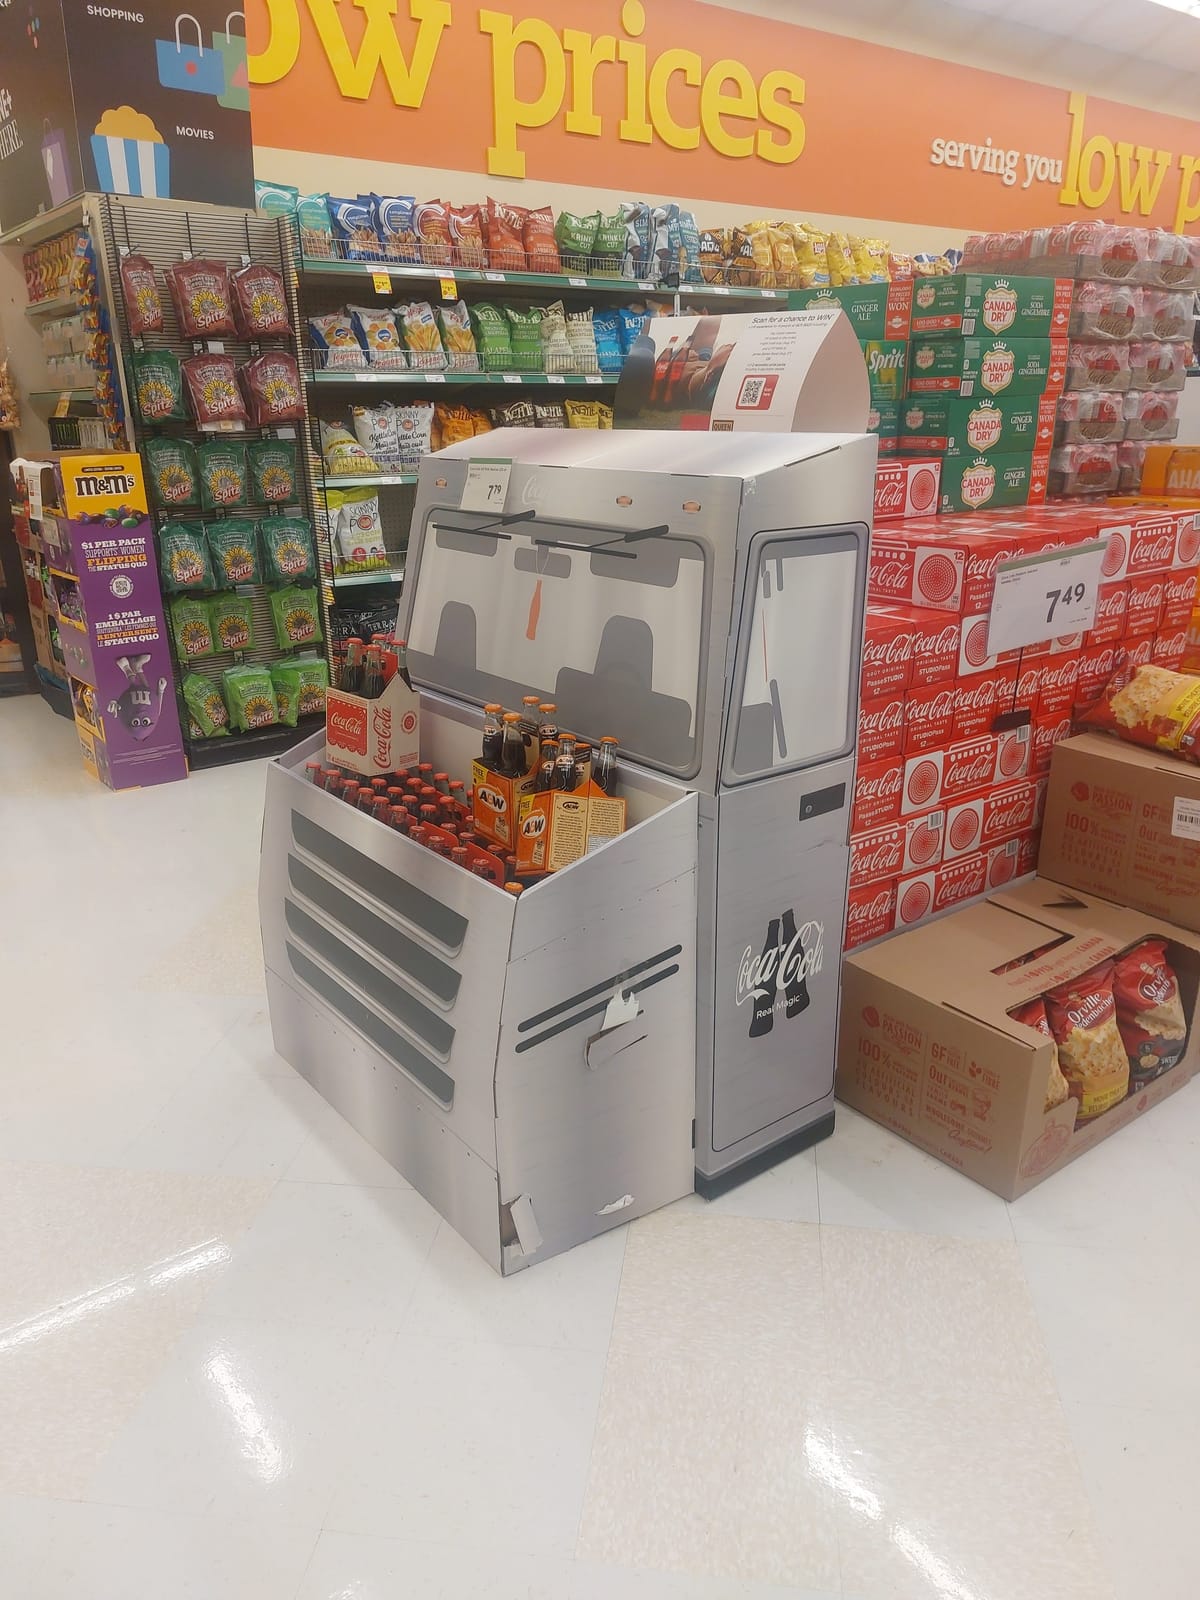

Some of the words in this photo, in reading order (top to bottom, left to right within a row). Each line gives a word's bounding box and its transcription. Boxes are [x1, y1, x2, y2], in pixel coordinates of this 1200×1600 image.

[87, 5, 144, 23] SHOPPING
[480, 0, 806, 178] prices
[176, 126, 214, 140] MOVIES
[1059, 91, 1172, 216] low
[930, 137, 1020, 187] serving
[1022, 153, 1062, 188] you
[852, 304, 878, 312] GINGER
[888, 302, 908, 311] WON
[984, 301, 1016, 311] CANADA
[197, 310, 225, 328] Spitz
[256, 312, 284, 328] Spitz
[991, 312, 1007, 322] DRY
[982, 363, 1014, 373] CANADA
[989, 373, 1005, 383] DRY
[142, 398, 172, 415] Spitz
[210, 396, 236, 414] Spitz
[271, 397, 296, 414] Spitz
[396, 419, 419, 431] POP
[968, 420, 1002, 431] CANADA
[1011, 416, 1033, 424] GINGER
[976, 431, 992, 441] DRY
[962, 477, 995, 488] CANADA
[1008, 479, 1020, 487] ALE
[164, 484, 191, 500] Spitz
[214, 486, 241, 501] Spitz
[265, 484, 292, 500] Spitz
[969, 488, 985, 498] DRY
[350, 499, 378, 515] SKINNY
[350, 512, 378, 534] POP
[118, 538, 146, 546] PACK
[85, 547, 118, 558] SUPPORTS
[120, 545, 144, 555] WOMEN
[954, 552, 964, 560] 12
[1130, 535, 1175, 566] Coca-Cola
[87, 554, 146, 566] FLIPPING
[96, 563, 130, 572] STATUS
[281, 557, 308, 573] Spitz
[176, 566, 204, 583] Spitz
[228, 565, 254, 581] Spitz
[1128, 583, 1163, 612] Coca-Cola
[96, 616, 156, 629] EMBALLAGE
[97, 627, 158, 640] RENVERSENT
[104, 637, 138, 646] STATU
[139, 634, 159, 642] QUO
[223, 632, 249, 648] Spitz
[290, 624, 315, 640] Spitz
[186, 637, 210, 654] Spitz
[863, 634, 915, 668] Coca-Cola
[915, 625, 960, 659] Coca-Cola
[919, 665, 950, 675] STUDIOPass
[996, 670, 1040, 701] Coca-Cola
[1040, 660, 1078, 691] Coca-Cola
[1079, 649, 1113, 678] Coca-Cola
[867, 673, 904, 687] PasseSTUDIO
[300, 700, 325, 714] Spitz
[859, 702, 904, 736] Coca-Cola
[905, 691, 954, 726] Coca-Cola
[953, 680, 998, 713] Coca-Cola
[249, 711, 273, 728] Spitz
[331, 712, 361, 734] Coca-Cola
[958, 717, 986, 728] STUDIOPass
[373, 706, 391, 768] Coca-Cola
[913, 729, 944, 740] STUDIOPass
[862, 741, 895, 753] STUDIOPass
[473, 764, 484, 776] FREE
[944, 752, 995, 789] Coca-Cola
[856, 767, 904, 803] Coca-Cola
[480, 790, 503, 809] A&W
[1092, 791, 1132, 811] PASSION
[859, 804, 894, 819] PasseSTUDIO
[984, 799, 1032, 834] Coca-Cola
[1143, 804, 1158, 818] GF
[524, 818, 544, 834] A&W
[1065, 811, 1089, 832] 100
[850, 840, 904, 877] Coca-Cola
[936, 867, 984, 906] Coca-Cola
[848, 888, 897, 927] Coca-Cola
[736, 920, 825, 1006] Coca-Cola
[756, 1004, 775, 1019] Real
[776, 993, 801, 1009] Magic
[1068, 992, 1103, 1024] Orville
[883, 1019, 922, 1049] PASSION
[859, 1038, 881, 1061] 100
[932, 1042, 947, 1060] GF
[929, 1065, 948, 1085] Our
